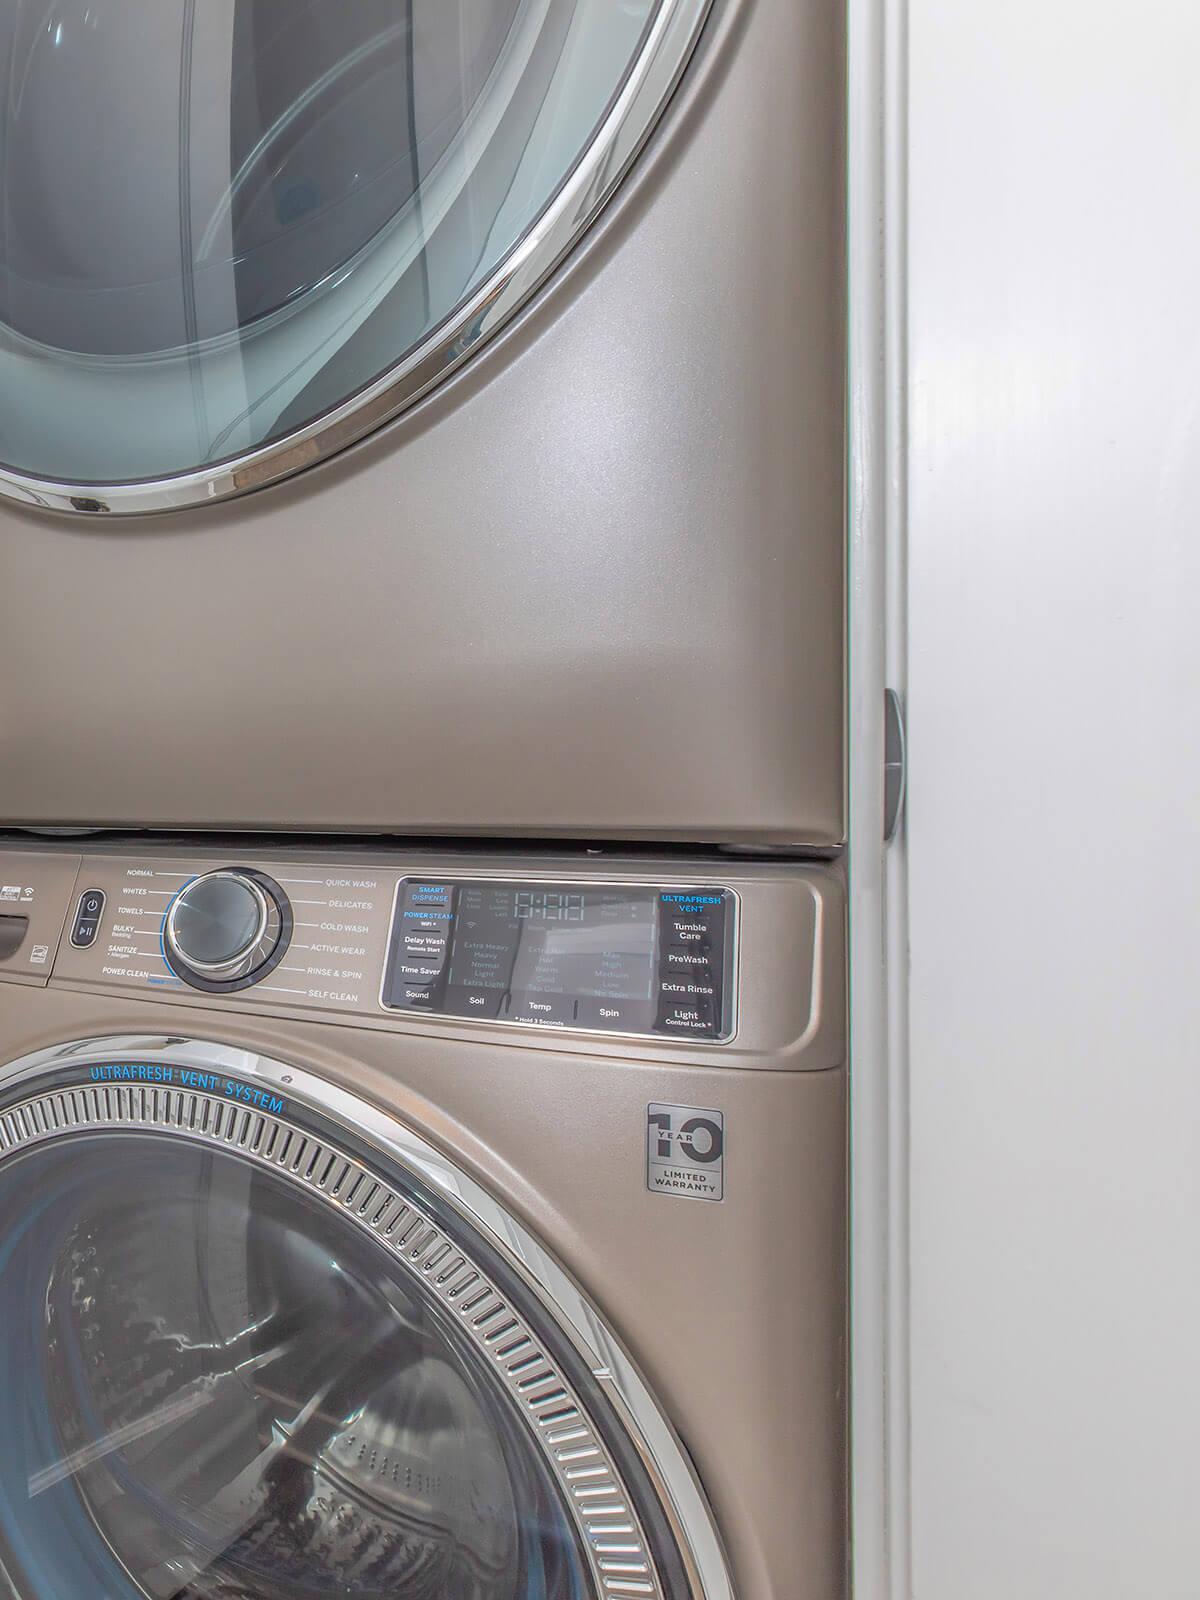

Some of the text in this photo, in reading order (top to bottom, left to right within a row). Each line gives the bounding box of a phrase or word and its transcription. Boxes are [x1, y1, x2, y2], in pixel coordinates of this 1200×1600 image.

[326, 879, 350, 887] QUICK
[662, 895, 721, 904] ULTRAFRESH
[329, 901, 373, 909] DELICATES
[118, 907, 144, 915] TOWELS
[320, 923, 368, 933] COLD WASH
[674, 923, 706, 931] Tumble
[404, 936, 445, 945] Delay Wash
[108, 945, 138, 954] SANITIZE
[310, 944, 365, 955] ACTIVE WEAR
[669, 955, 708, 964] PreWash
[103, 967, 149, 978] POWER CLEAN
[342, 970, 362, 979] SPIN
[662, 983, 713, 994] Extra Rinse
[329, 992, 358, 1001] CLEAN
[406, 990, 429, 999] Sound
[469, 997, 484, 1005] Soil
[529, 1002, 551, 1011] Temp
[600, 1008, 620, 1017] Spin
[674, 1010, 698, 1020] Light
[89, 1065, 284, 1114] ULTRAFRESH VENT SYSTEM
[648, 1114, 723, 1163] 10
[658, 1131, 693, 1141] YEAR
[664, 1170, 706, 1182] LIMITED
[655, 1178, 716, 1192] WARRANTY
